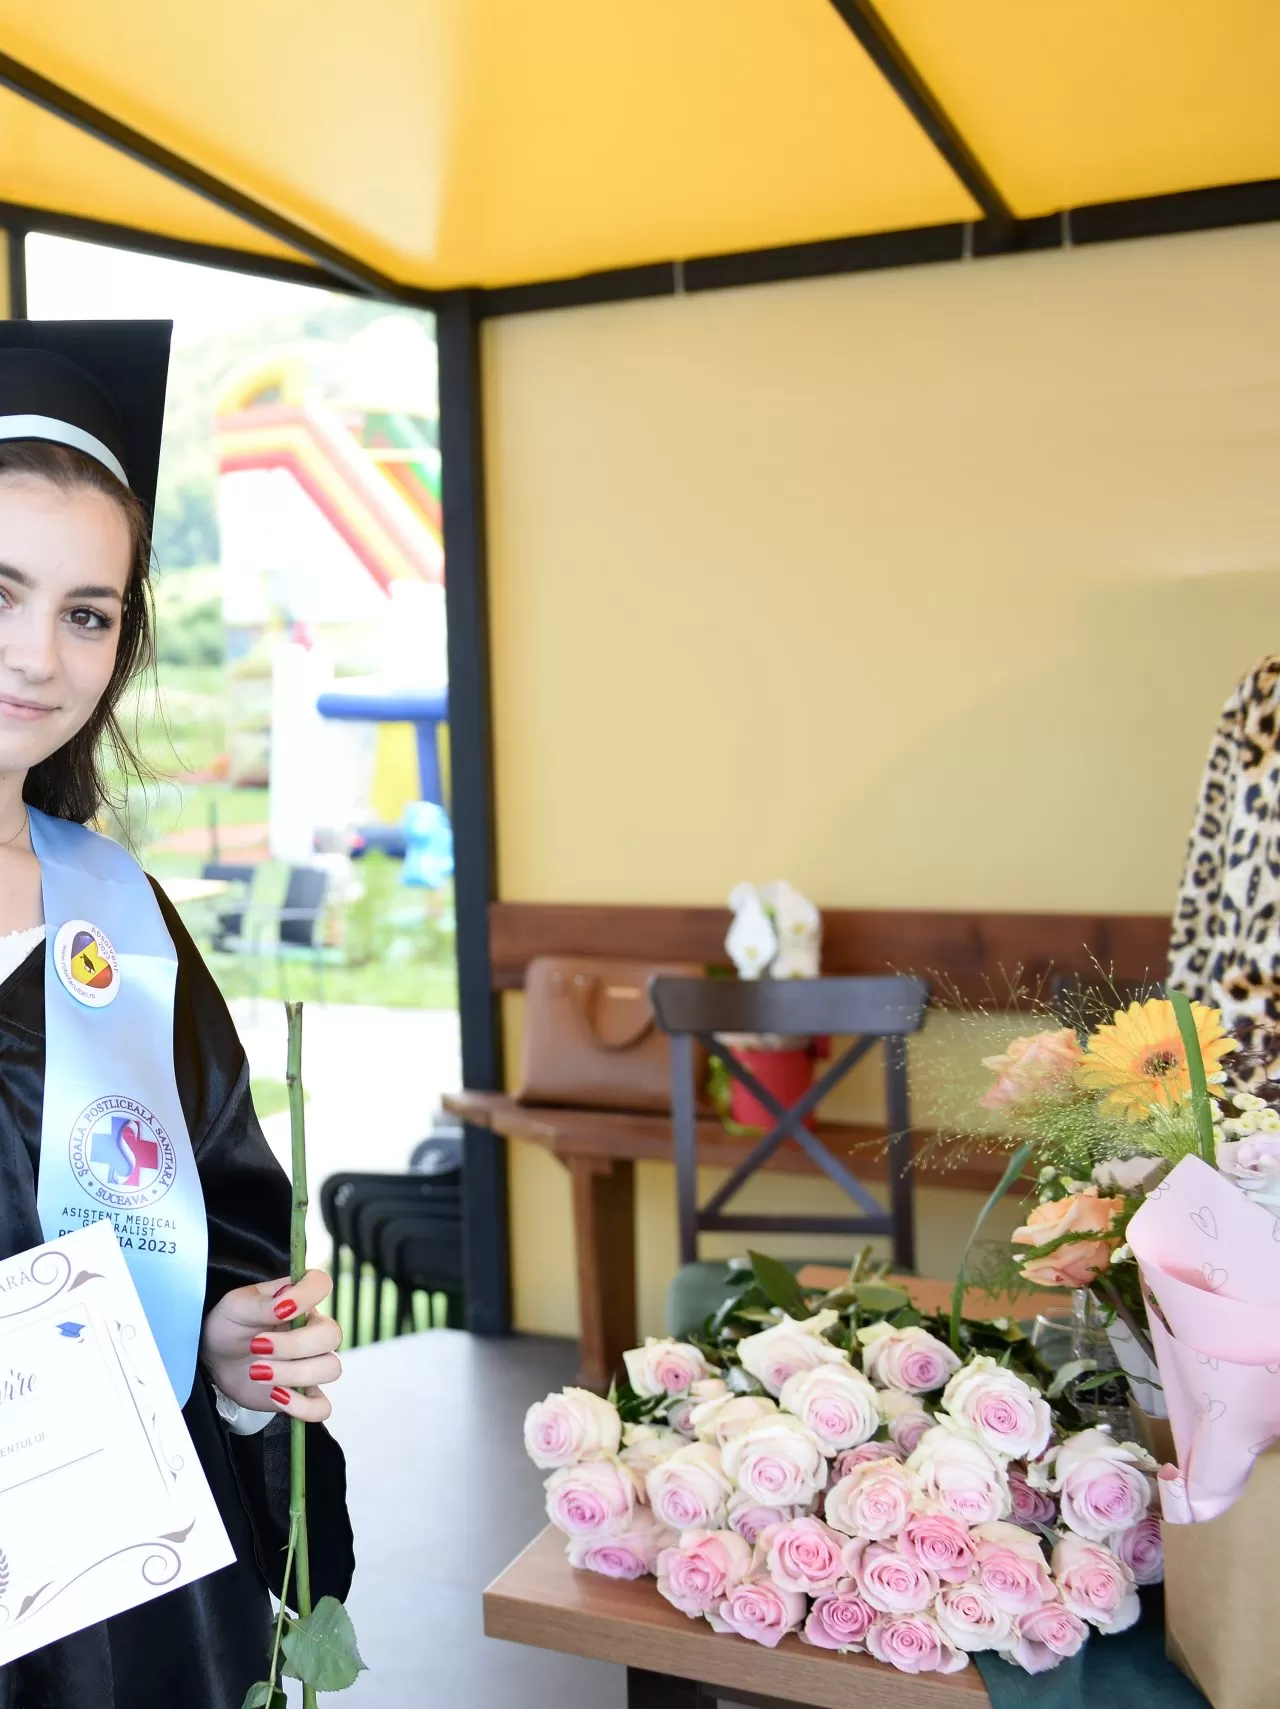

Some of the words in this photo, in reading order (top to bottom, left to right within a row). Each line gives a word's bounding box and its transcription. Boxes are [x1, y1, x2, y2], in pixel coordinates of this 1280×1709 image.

[91, 926, 118, 972] Absolvent
[98, 942, 111, 960] 2023
[95, 1187, 148, 1206] SUCEAVA
[62, 1206, 120, 1222] ASISTENT
[126, 1214, 177, 1229] MEDICAL
[82, 1219, 155, 1237] GRALIST
[138, 1238, 177, 1254] 2023
